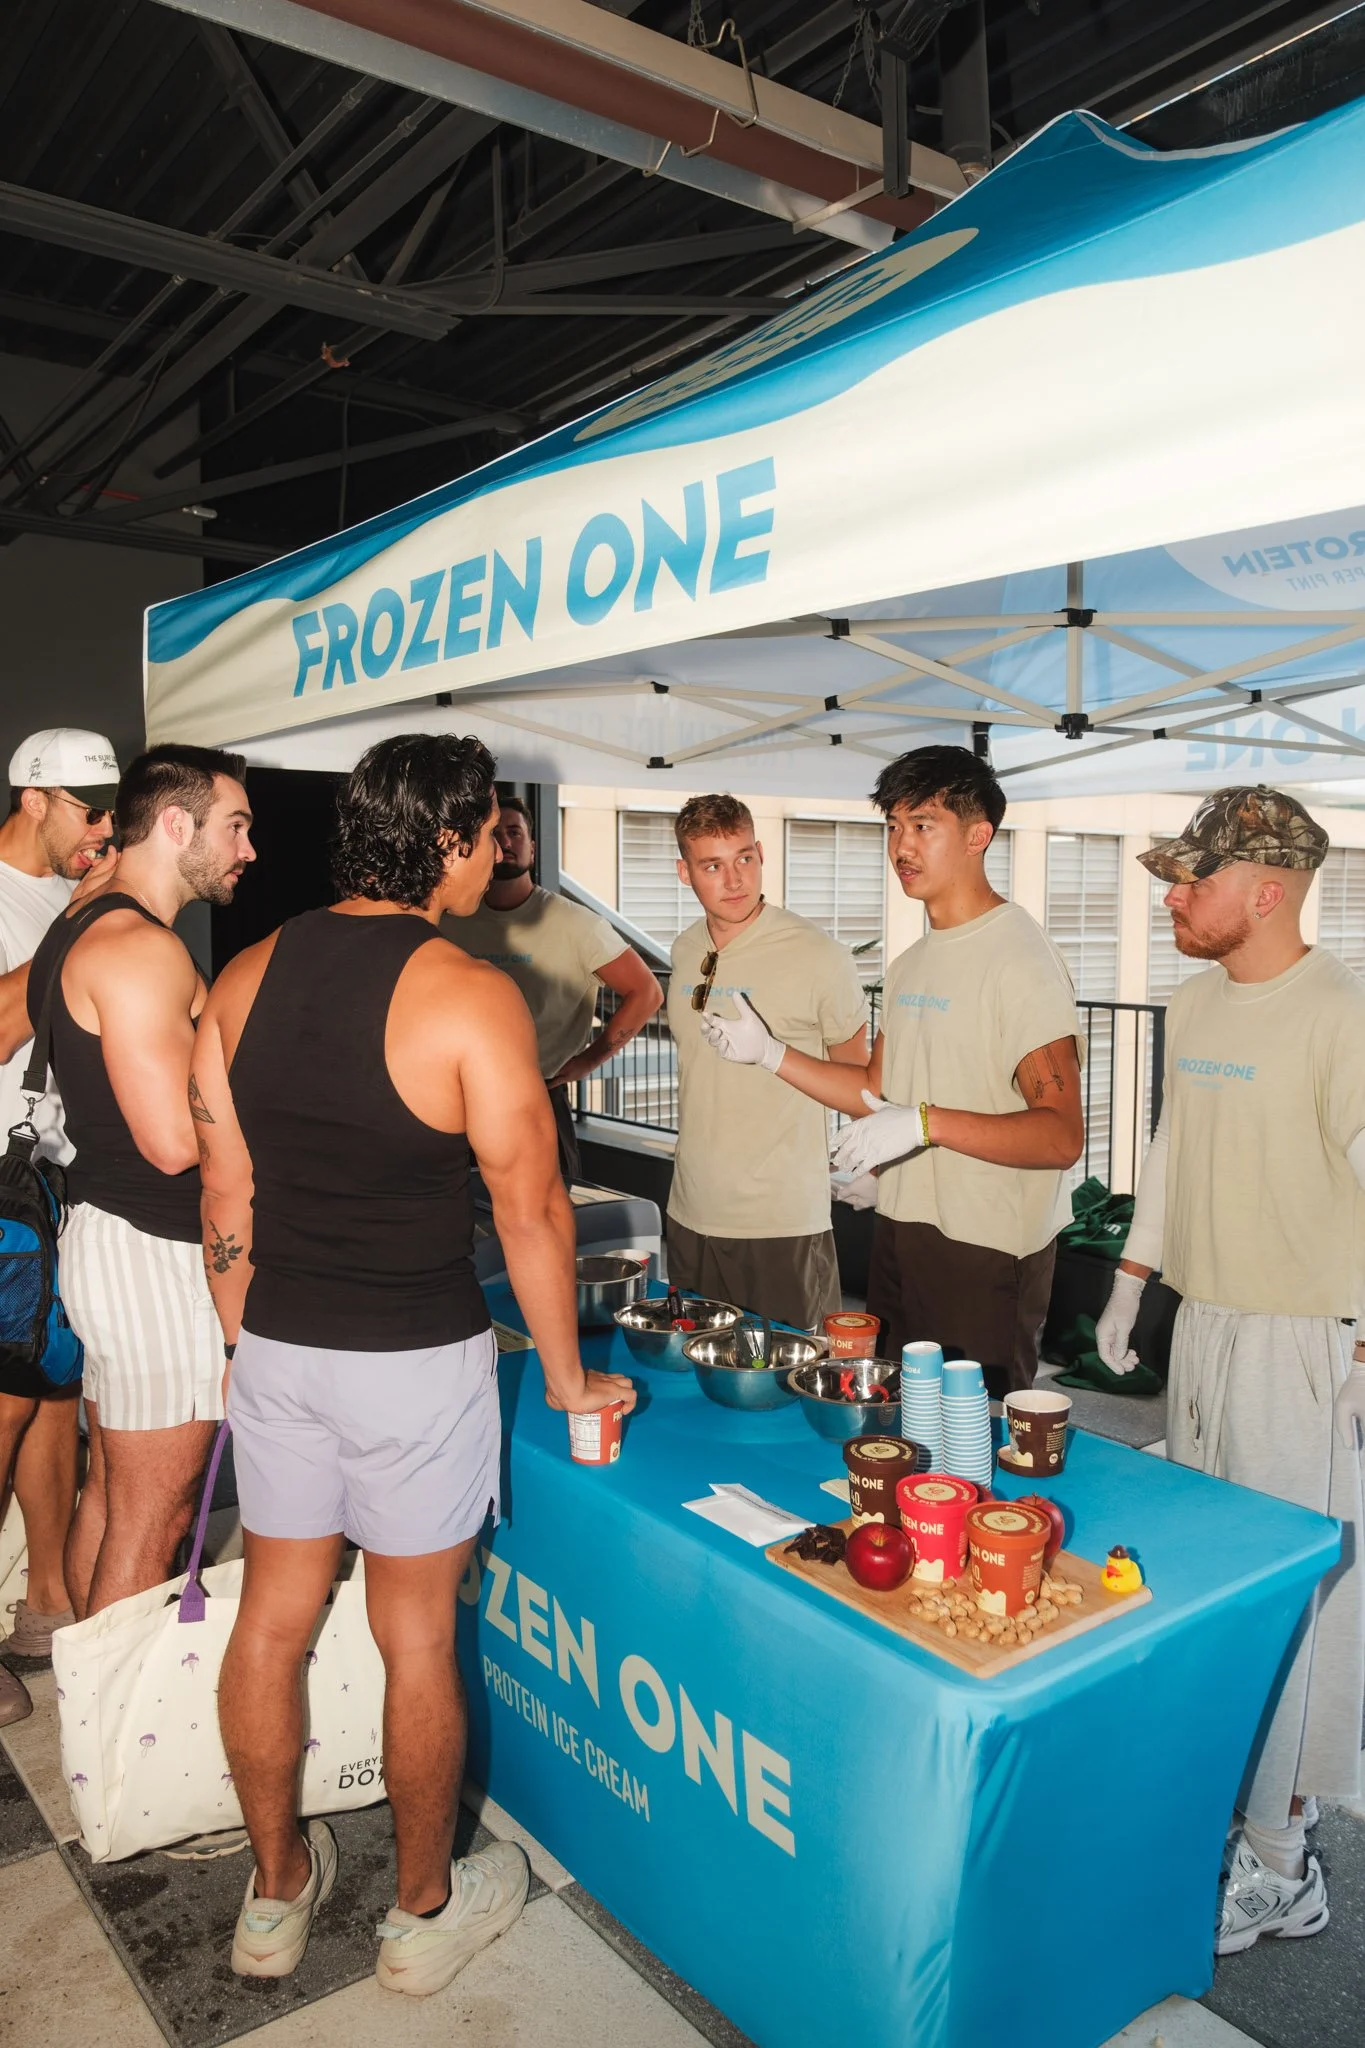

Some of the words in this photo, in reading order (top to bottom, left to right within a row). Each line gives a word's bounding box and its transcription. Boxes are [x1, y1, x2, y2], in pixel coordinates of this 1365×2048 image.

[292, 537, 542, 698] FROZEN
[566, 456, 777, 626] ONE
[927, 996, 951, 1011] ONE
[1176, 1056, 1222, 1075] FROZEN
[1223, 1063, 1256, 1081] ONE
[1013, 1420, 1031, 1432] ONE
[862, 1477, 884, 1490] ONE
[920, 1521, 944, 1535] ONE
[981, 1551, 1005, 1566] ONE
[483, 1655, 548, 1739] PROTEIN
[552, 1710, 582, 1765] ICE
[584, 1738, 651, 1823] CREAM
[618, 1654, 796, 1858] ONE
